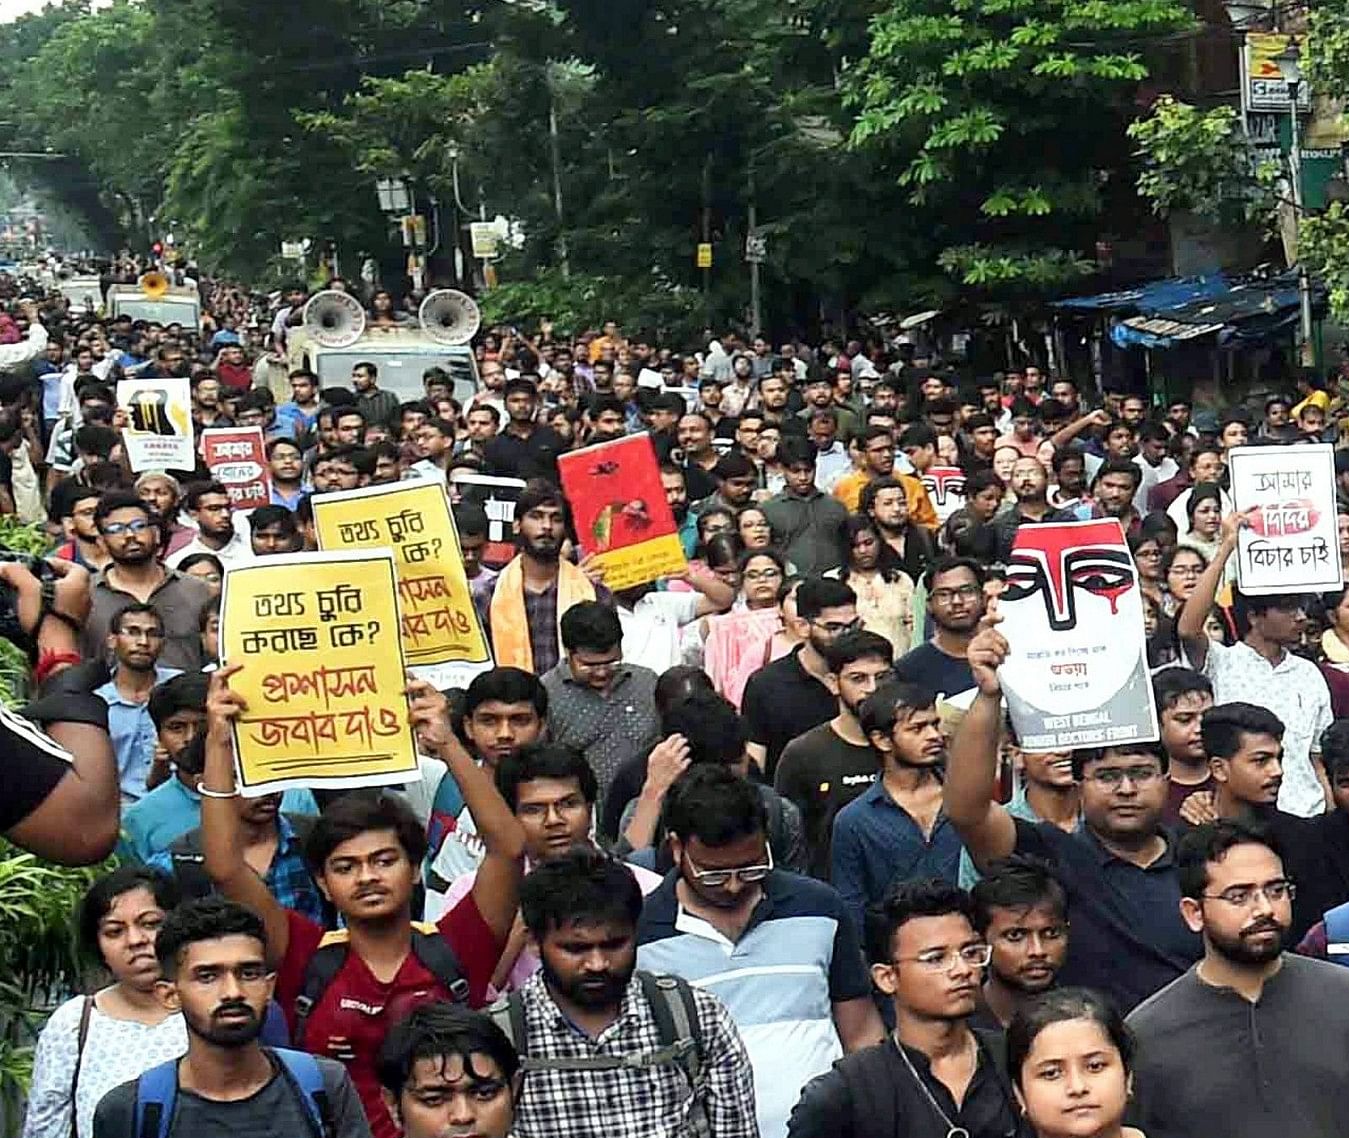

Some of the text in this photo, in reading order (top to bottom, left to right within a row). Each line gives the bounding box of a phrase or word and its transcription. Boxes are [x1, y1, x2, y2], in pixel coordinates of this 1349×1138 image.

[338, 509, 424, 545] তথ্য চুরি
[402, 537, 443, 564] কে?
[1247, 536, 1330, 574] বিচার চাই
[253, 583, 363, 623] তথ্য চুরি
[240, 620, 381, 654] করছে কে?
[426, 605, 472, 641] দাও
[262, 662, 378, 711] প্রশাসন
[239, 704, 402, 755] জবাব দাও
